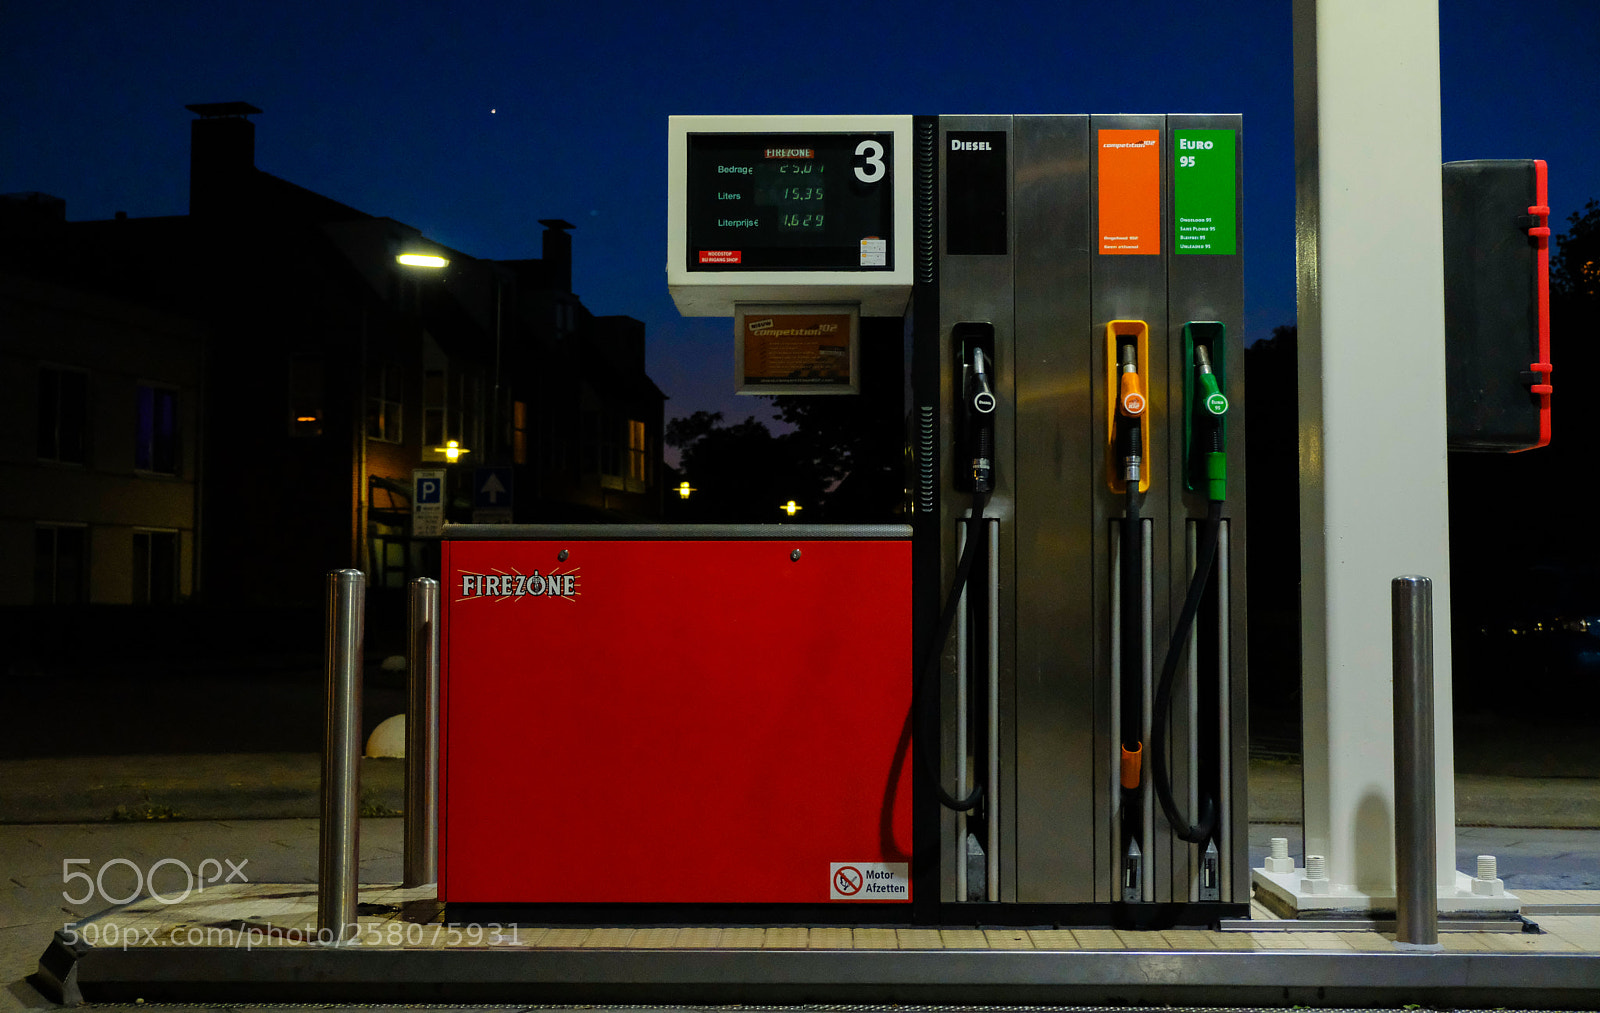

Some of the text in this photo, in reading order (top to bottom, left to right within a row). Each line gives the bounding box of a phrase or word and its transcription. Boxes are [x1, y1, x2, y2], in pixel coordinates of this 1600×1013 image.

[951, 139, 992, 151] DIESEL
[1179, 138, 1213, 150] EURO
[853, 140, 886, 183] 3
[1179, 155, 1196, 168] 95
[717, 192, 741, 200] Liters
[422, 481, 436, 501] P
[462, 570, 576, 596] FIREZONE
[865, 869, 895, 880] Motor
[865, 882, 906, 893] Afzetten
